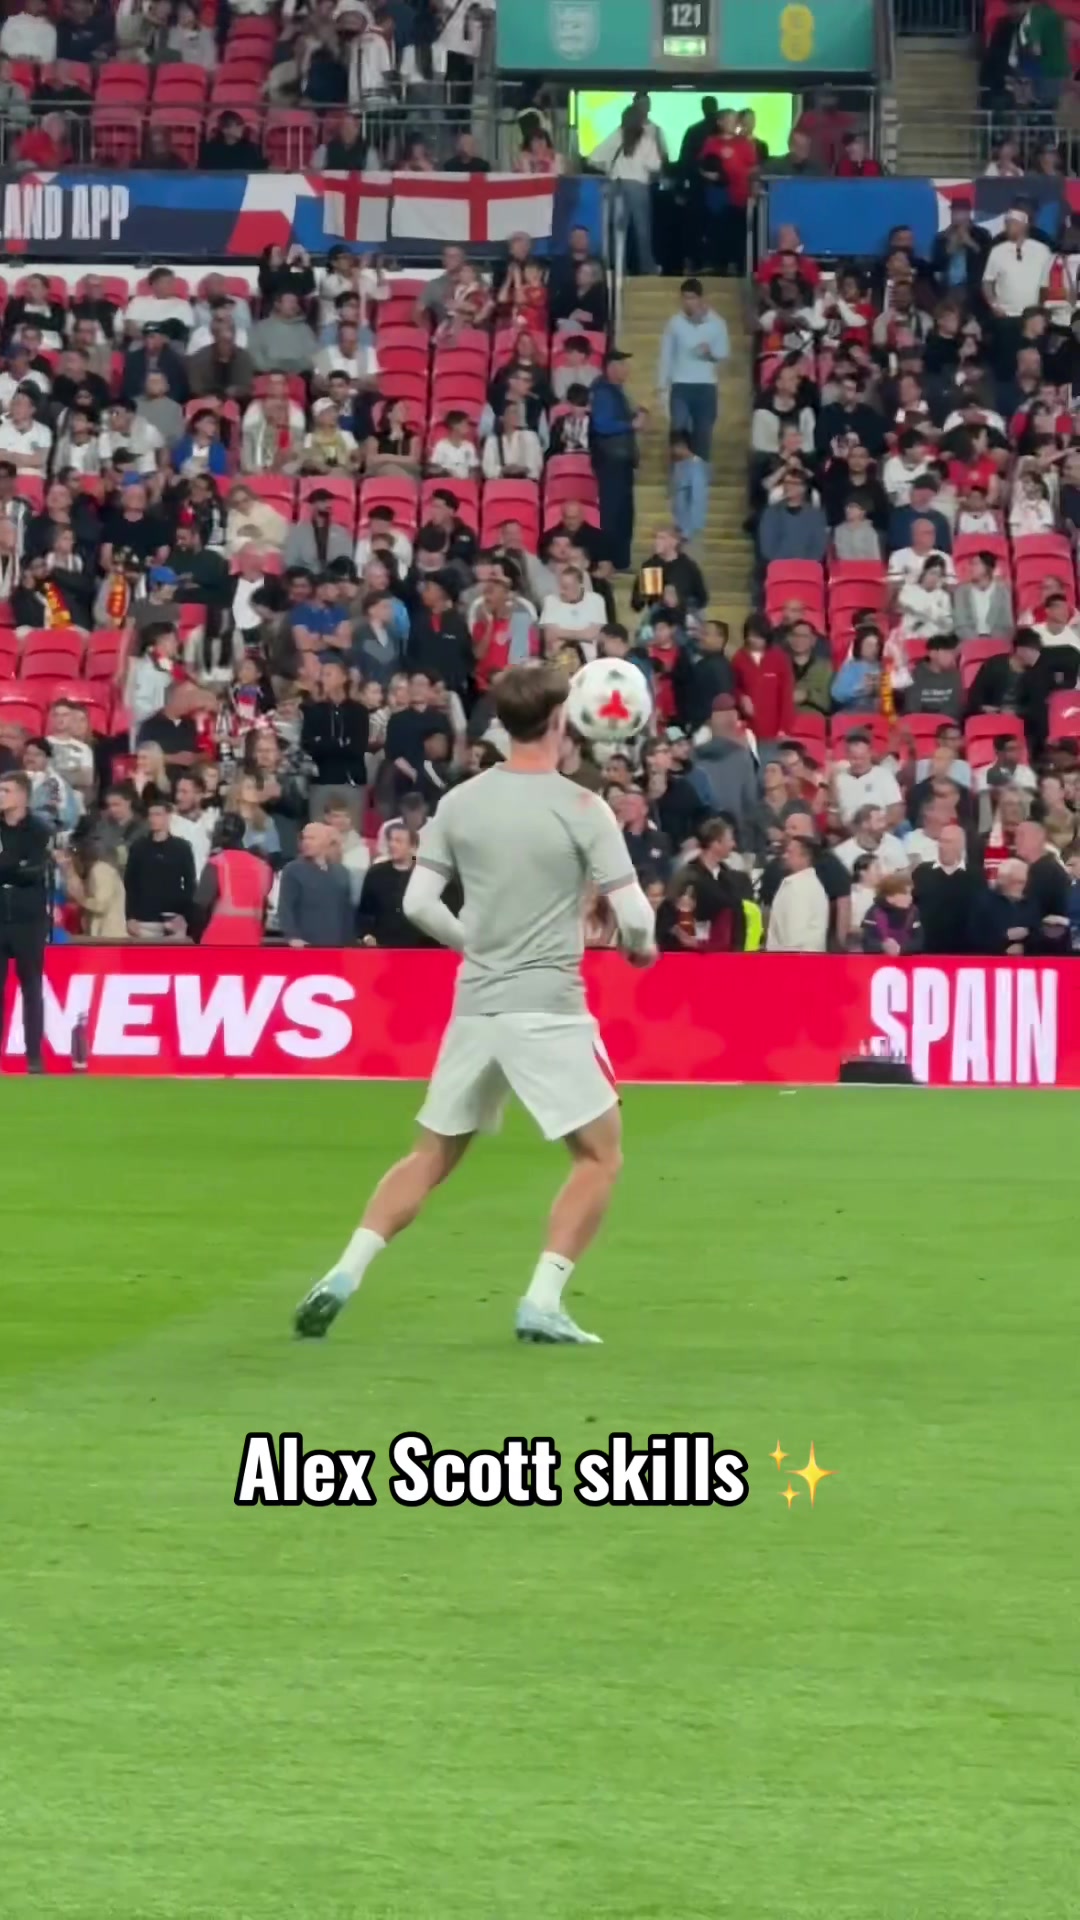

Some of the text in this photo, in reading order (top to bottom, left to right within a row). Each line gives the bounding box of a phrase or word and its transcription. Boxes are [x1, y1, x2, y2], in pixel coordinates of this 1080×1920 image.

[672, 3, 702, 28] 121
[0, 183, 130, 240] AND APP
[2, 974, 355, 1058] NEWS
[870, 966, 1058, 1084] SPAIN
